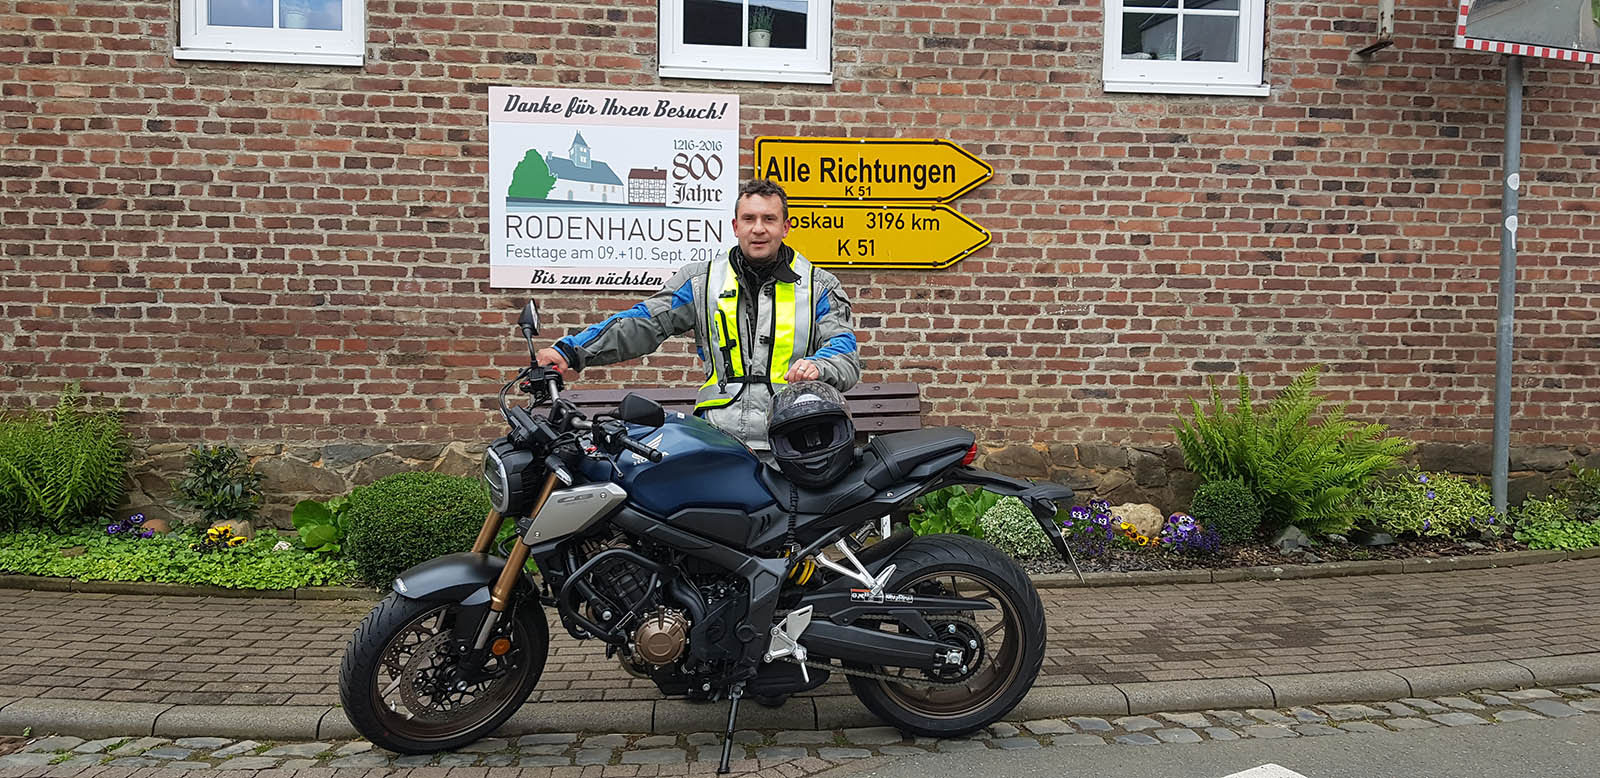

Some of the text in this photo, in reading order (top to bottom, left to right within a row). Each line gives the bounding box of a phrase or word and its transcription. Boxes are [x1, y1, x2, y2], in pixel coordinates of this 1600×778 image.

[503, 94, 729, 120] Danke für Ihren Besuch!
[673, 139, 723, 151] 1216-2016
[672, 152, 724, 181] 800
[765, 156, 957, 191] Alle Richtungen
[672, 182, 723, 205] Jahre
[845, 186, 872, 196] K 51
[505, 215, 723, 243] RODENHAUSEN
[790, 211, 940, 231] oskau 3196 km
[505, 244, 567, 262] Festtage
[571, 249, 594, 259] am
[598, 246, 647, 262] 09.+10.
[651, 247, 687, 264] Sept.
[838, 239, 876, 256] K 51
[530, 269, 556, 285] Bis
[562, 273, 592, 285] zum
[595, 272, 664, 286] nächsten
